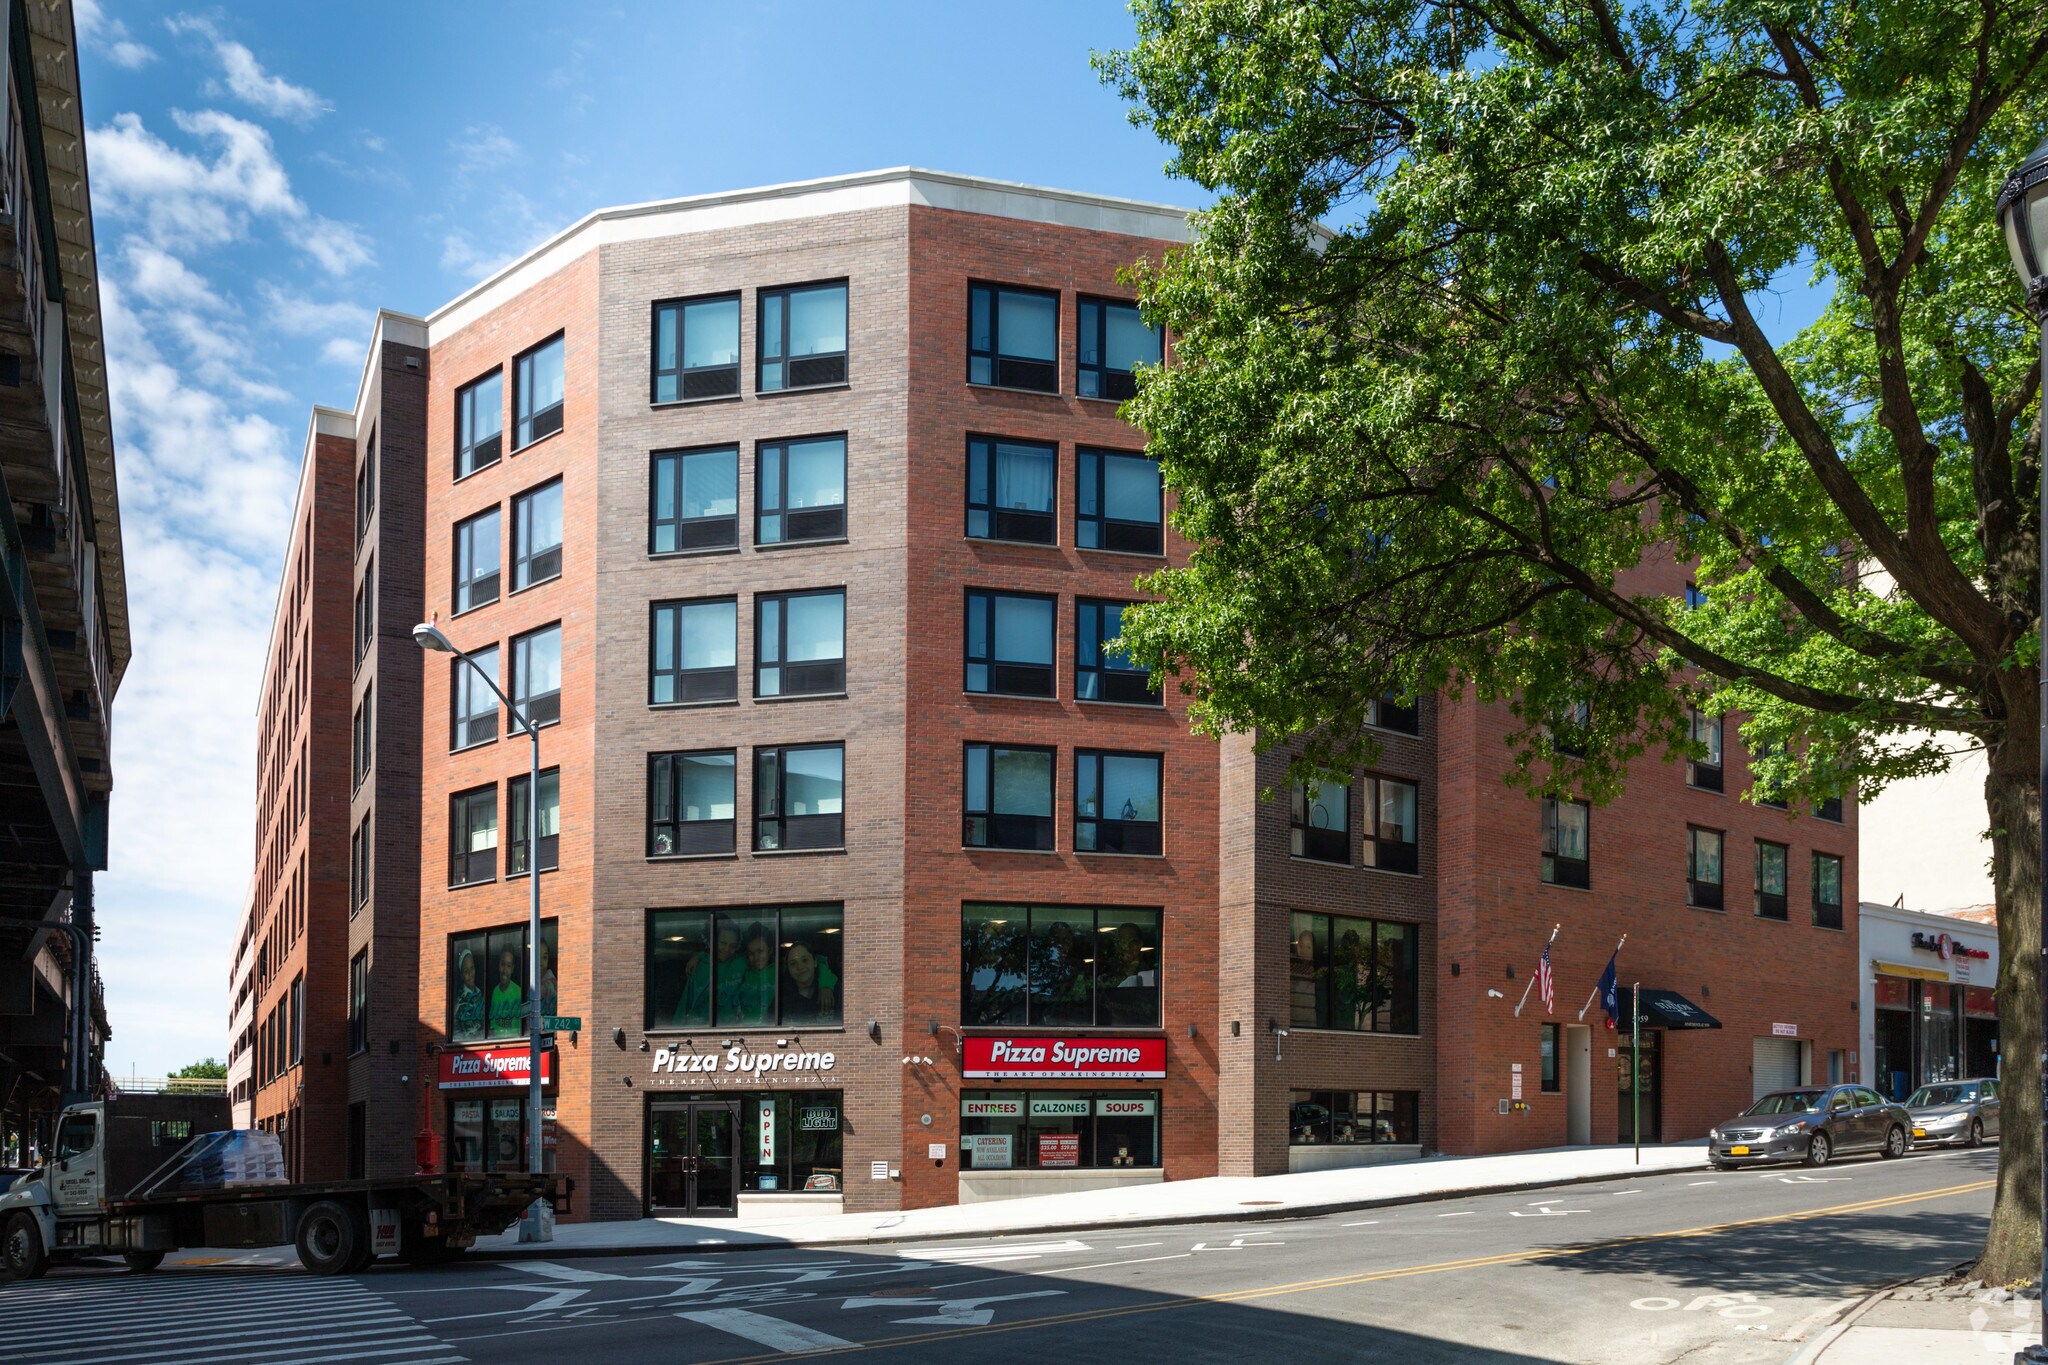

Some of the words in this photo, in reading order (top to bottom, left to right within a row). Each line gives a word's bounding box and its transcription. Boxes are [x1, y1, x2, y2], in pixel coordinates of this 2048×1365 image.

[544, 1019, 550, 1029] W
[554, 1018, 571, 1029] 242
[1632, 1015, 1649, 1023] 59
[990, 1040, 1046, 1063] Pizza
[1051, 1041, 1141, 1069] Supreme
[452, 1054, 481, 1074] Pizza
[652, 1048, 719, 1073] Pizza
[724, 1046, 836, 1078] Supreme
[968, 1103, 1017, 1113] ENTREES
[1033, 1103, 1087, 1113] CALZONES
[1105, 1103, 1144, 1113] SOUPS
[461, 1110, 480, 1118] PASTA
[495, 1109, 519, 1118] SALADS
[806, 1109, 831, 1118] BUD
[802, 1118, 836, 1127] LIGHT
[762, 1107, 771, 1158] OPEN
[977, 1137, 1007, 1145] CATERING
